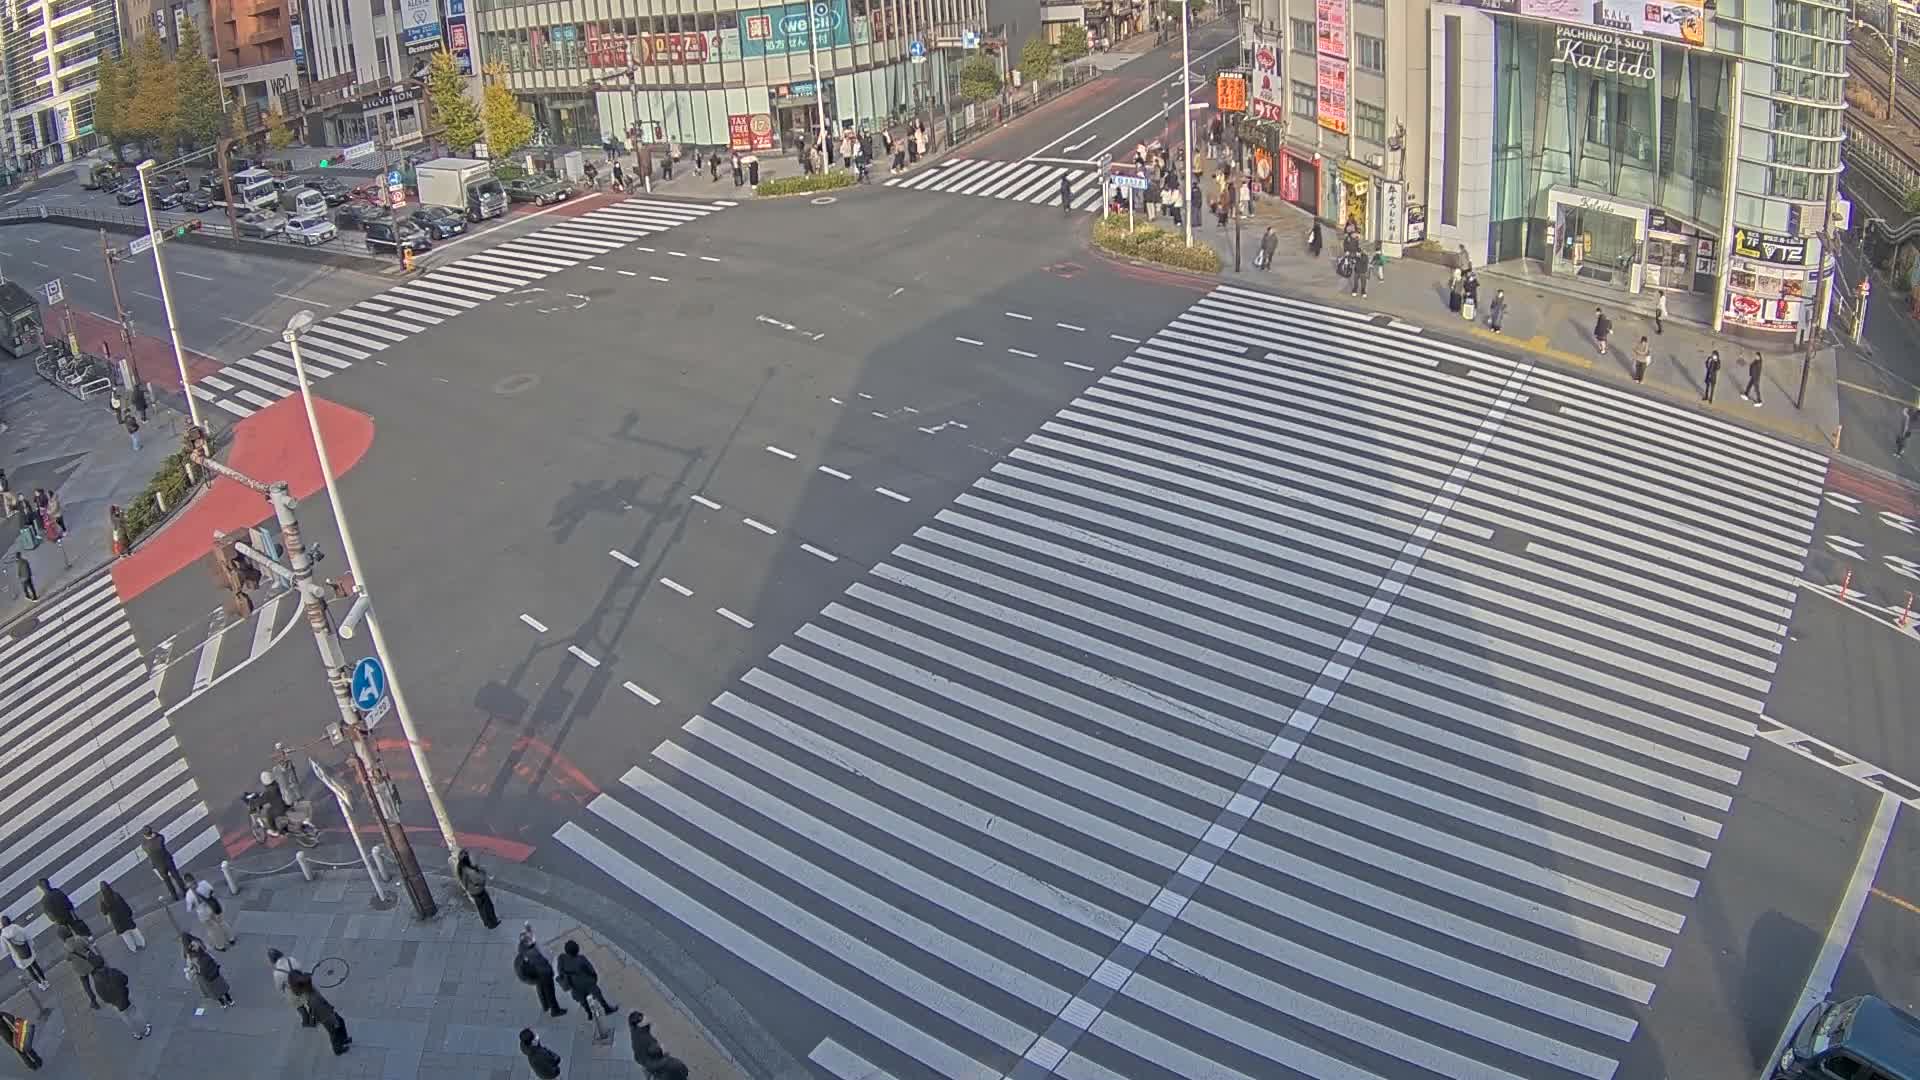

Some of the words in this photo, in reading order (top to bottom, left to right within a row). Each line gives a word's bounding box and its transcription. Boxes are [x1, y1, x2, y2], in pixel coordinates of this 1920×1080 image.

[765, 34, 828, 50] 処方せん付
[1556, 26, 1613, 44] PACHINKO
[1624, 39, 1652, 51] SLOT
[1551, 38, 1656, 80] Kaleido
